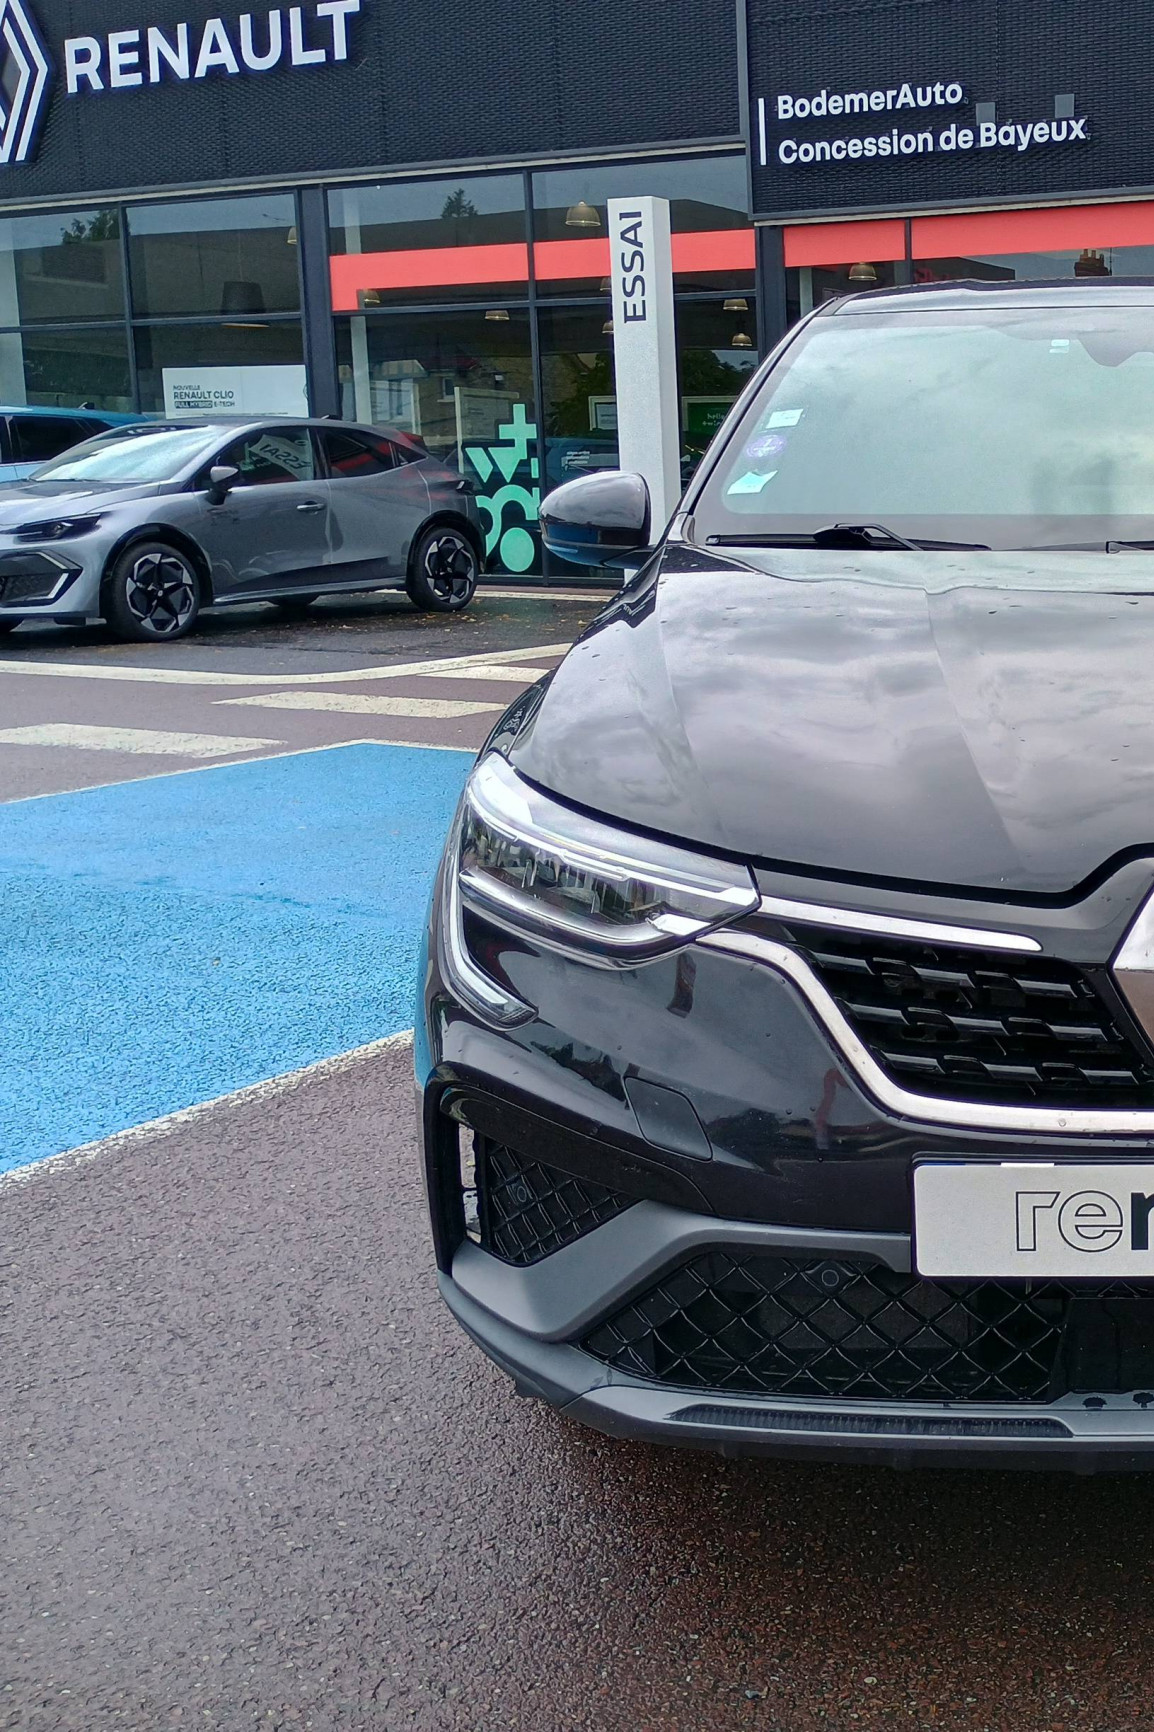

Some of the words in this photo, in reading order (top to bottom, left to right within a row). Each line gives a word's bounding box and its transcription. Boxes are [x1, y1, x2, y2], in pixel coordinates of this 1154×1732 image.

[64, 0, 361, 94] RENAULT
[777, 81, 963, 120] BodemerAuto
[778, 128, 934, 165] Concession
[939, 123, 974, 151] de
[979, 117, 1087, 152] Bayeux
[618, 210, 647, 324] ESSAI
[173, 391, 211, 400] RENAULT
[213, 390, 234, 399] CLIO
